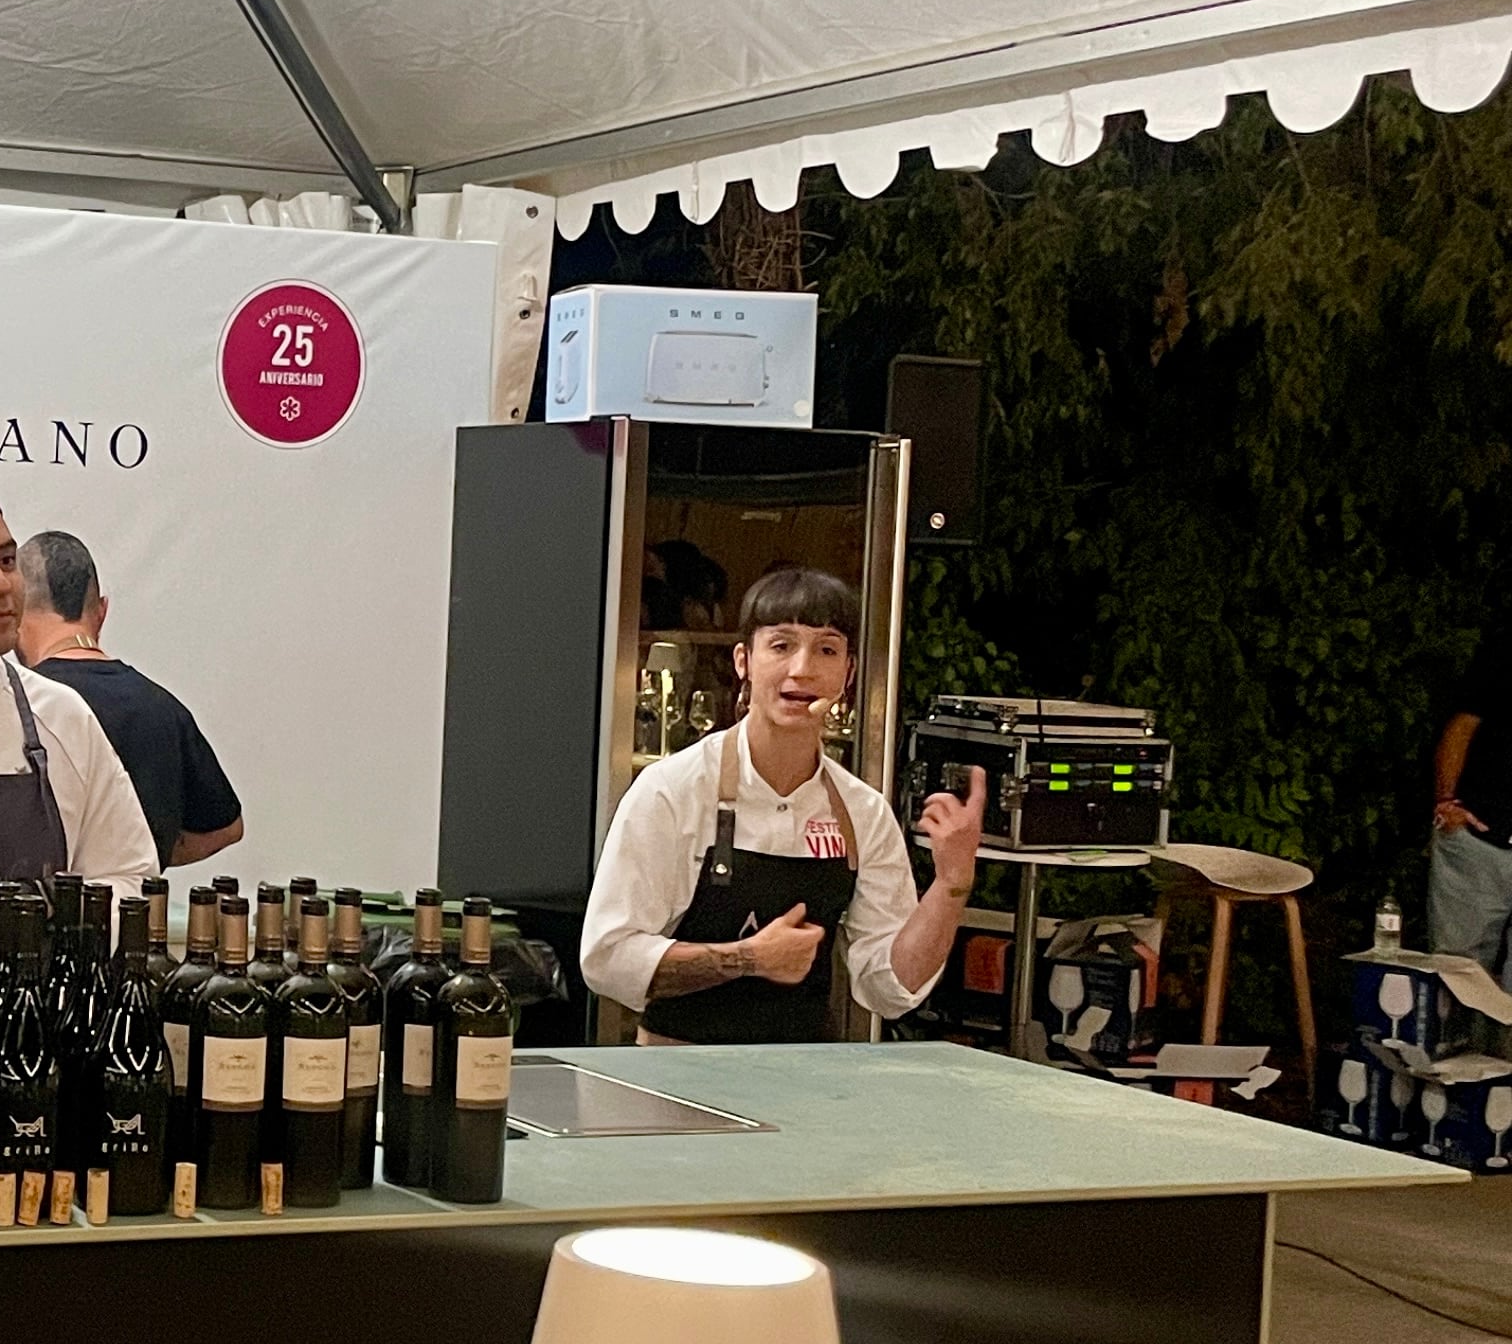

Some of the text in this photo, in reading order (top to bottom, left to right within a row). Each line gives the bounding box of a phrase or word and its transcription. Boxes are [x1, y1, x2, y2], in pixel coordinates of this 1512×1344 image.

[258, 304, 329, 332] EXPERIENCIA
[271, 323, 314, 367] 25
[259, 370, 324, 387] ANIVERSARIO
